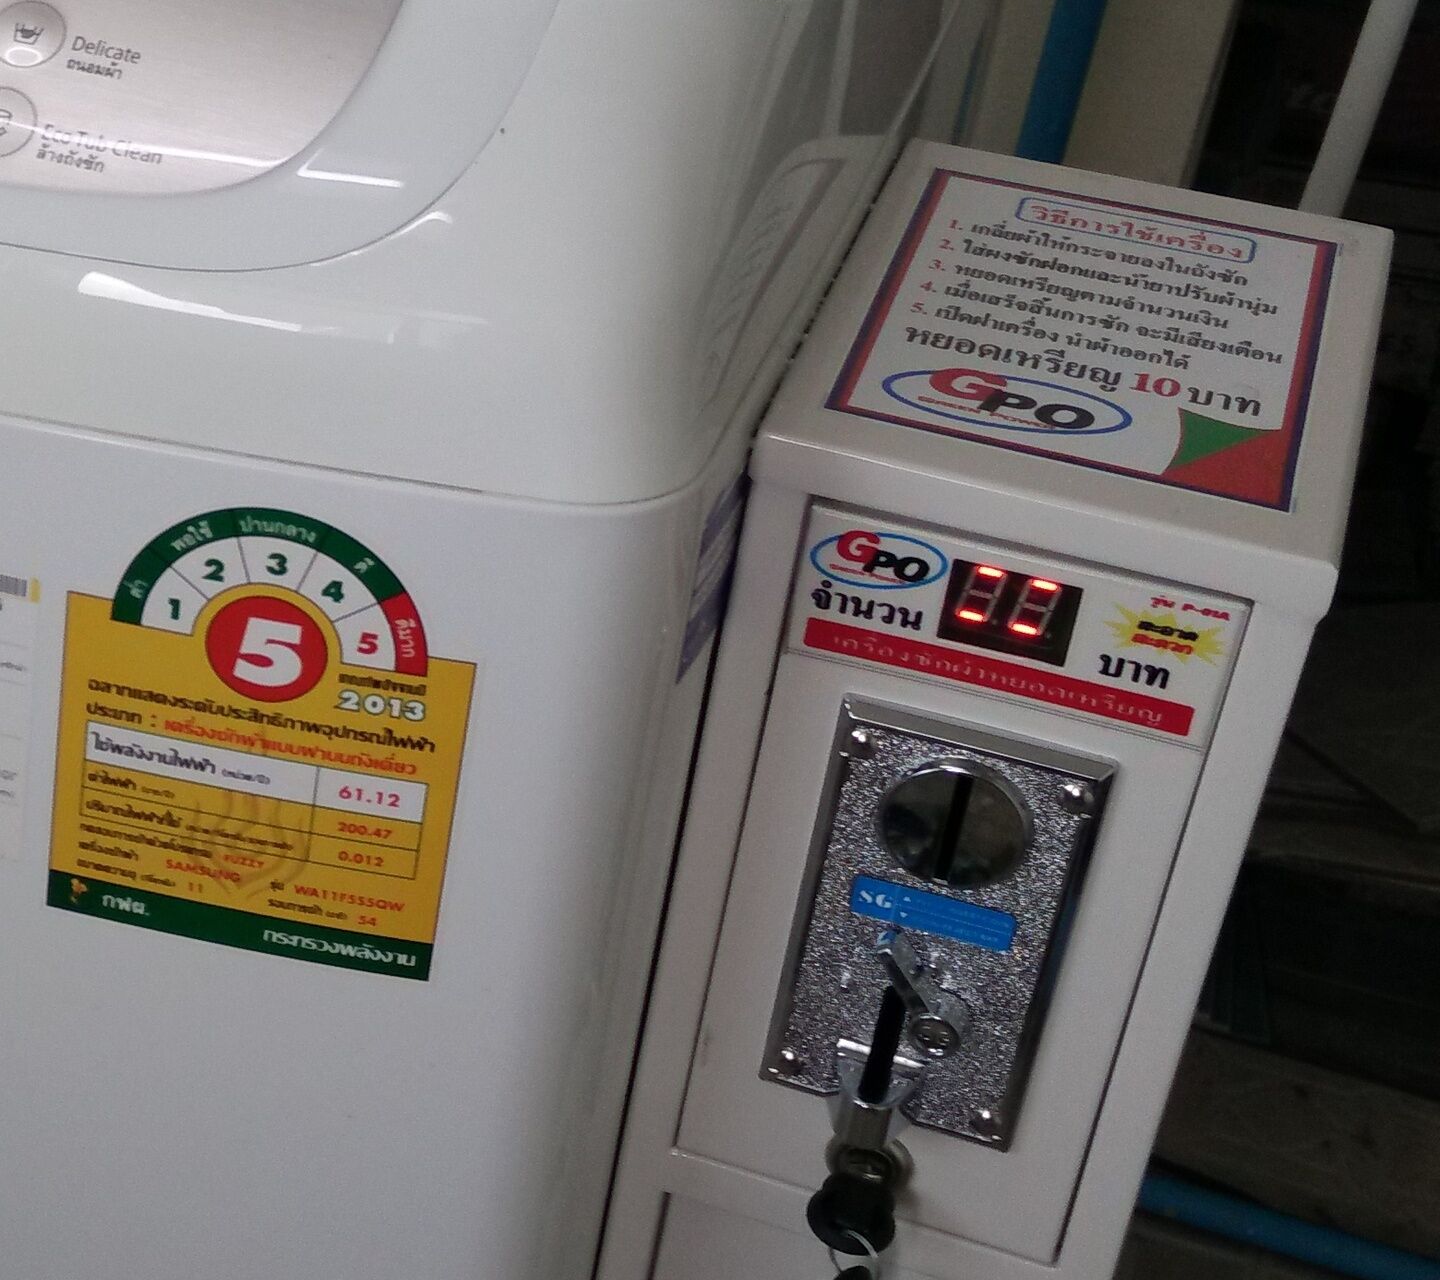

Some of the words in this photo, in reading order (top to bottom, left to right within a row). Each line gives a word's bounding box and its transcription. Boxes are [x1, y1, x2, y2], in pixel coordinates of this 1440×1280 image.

[71, 36, 142, 65] Delicate
[66, 58, 123, 81] ถนอมผ้า
[949, 219, 963, 231] 1.
[1031, 204, 1243, 259] วิธีการใช้เครื่อง
[939, 238, 955, 251] 2.
[928, 259, 946, 271] 3.
[954, 264, 1230, 329] หยอดเหรียญตามจำนวนเงิน
[910, 302, 928, 315] 5.
[935, 304, 1059, 343] เปิดฝาเครื่อง
[1065, 332, 1192, 370] นำผ้าออกได้
[920, 280, 937, 293] 4.
[1136, 325, 1283, 365] จะมีเสียงเตือน
[905, 326, 1122, 393] หยอดเหรียญ
[1129, 373, 1181, 397] 10
[1187, 386, 1262, 417] บาท
[929, 368, 1095, 430] GPO
[171, 521, 213, 552] พอใช้
[238, 517, 317, 544] ปานกลาง
[202, 558, 225, 582] 2
[265, 552, 289, 576] 3
[837, 530, 930, 582] GPO
[321, 580, 345, 604] 4
[811, 580, 924, 631] จำนวน
[168, 598, 181, 620] 1
[232, 616, 304, 688] 5
[356, 632, 380, 655] 5
[1098, 654, 1171, 690] บาท
[334, 688, 426, 722] 2013
[90, 731, 217, 775] ใช้พลังงานไฟฟ้า
[338, 785, 401, 809] 61.12
[337, 821, 393, 840] 200.47
[166, 858, 241, 885] SAMSUNG
[338, 849, 385, 869] 0.012
[860, 889, 893, 910] SG
[263, 928, 416, 967] กระทรวงพลังงาน
